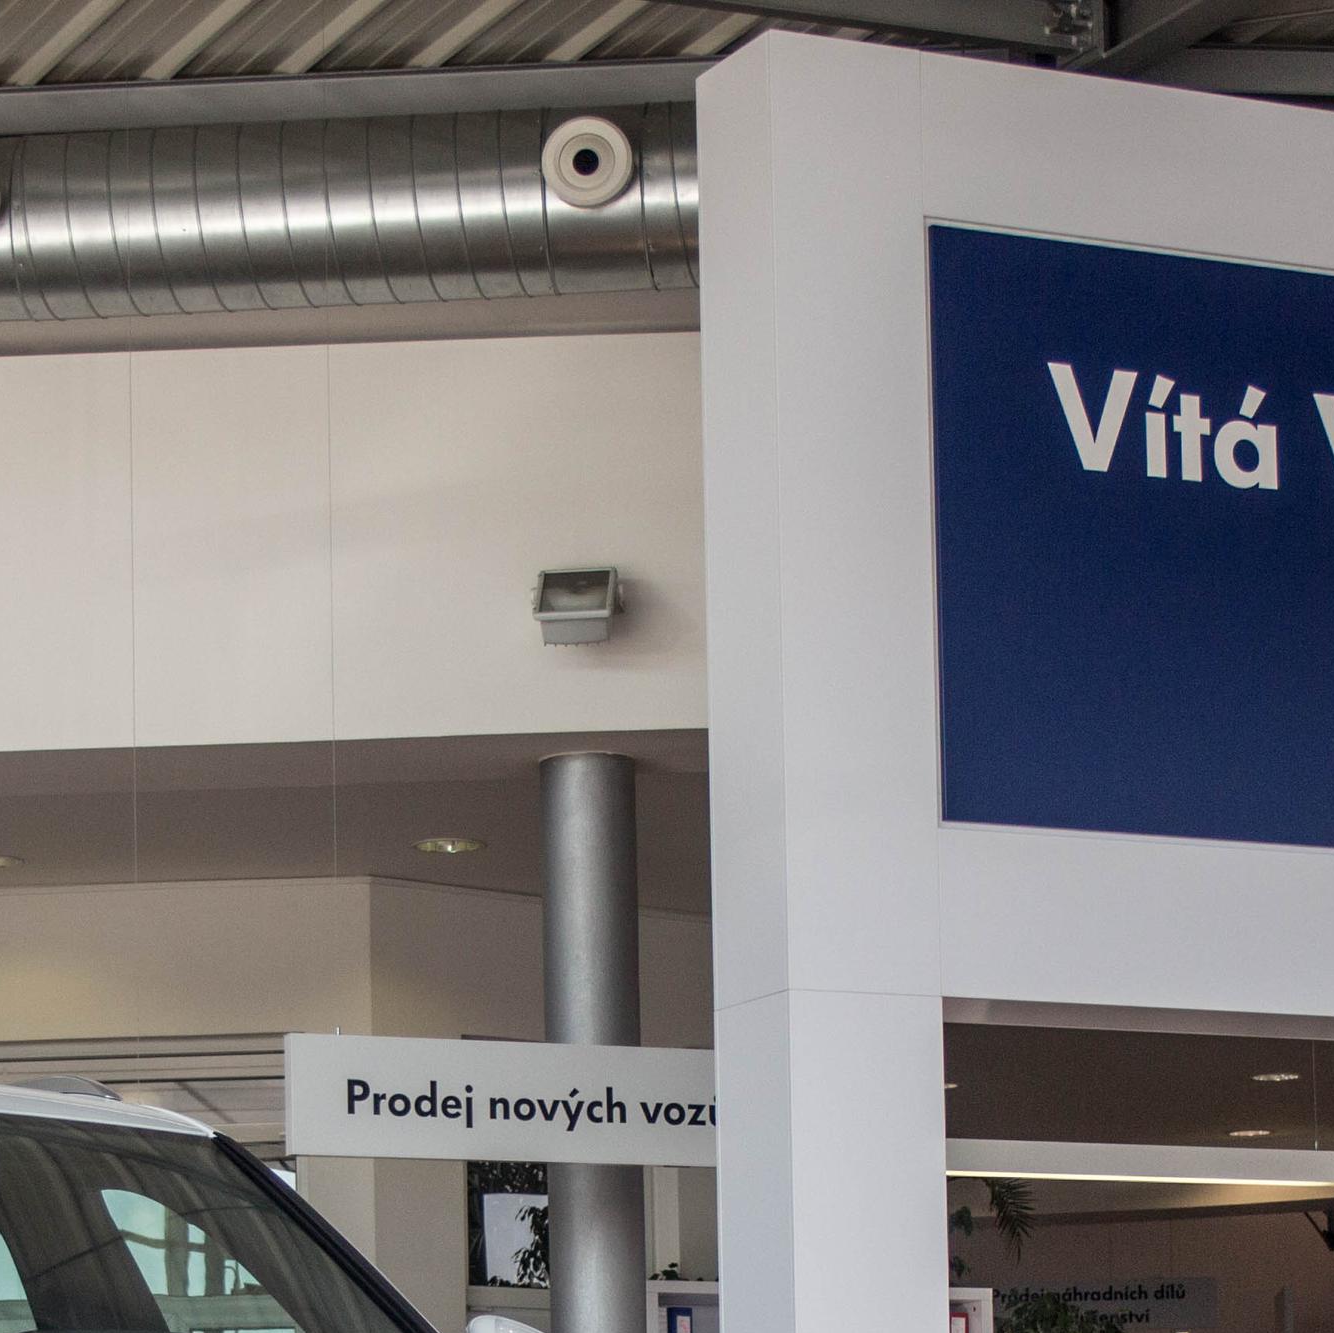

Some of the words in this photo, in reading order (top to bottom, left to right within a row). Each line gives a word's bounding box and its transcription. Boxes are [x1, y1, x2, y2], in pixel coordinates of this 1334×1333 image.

[1047, 361, 1279, 491] Vítá
[346, 1080, 474, 1128] Prodej
[489, 1086, 628, 1132] nových
[1153, 1283, 1187, 1300] dílů
